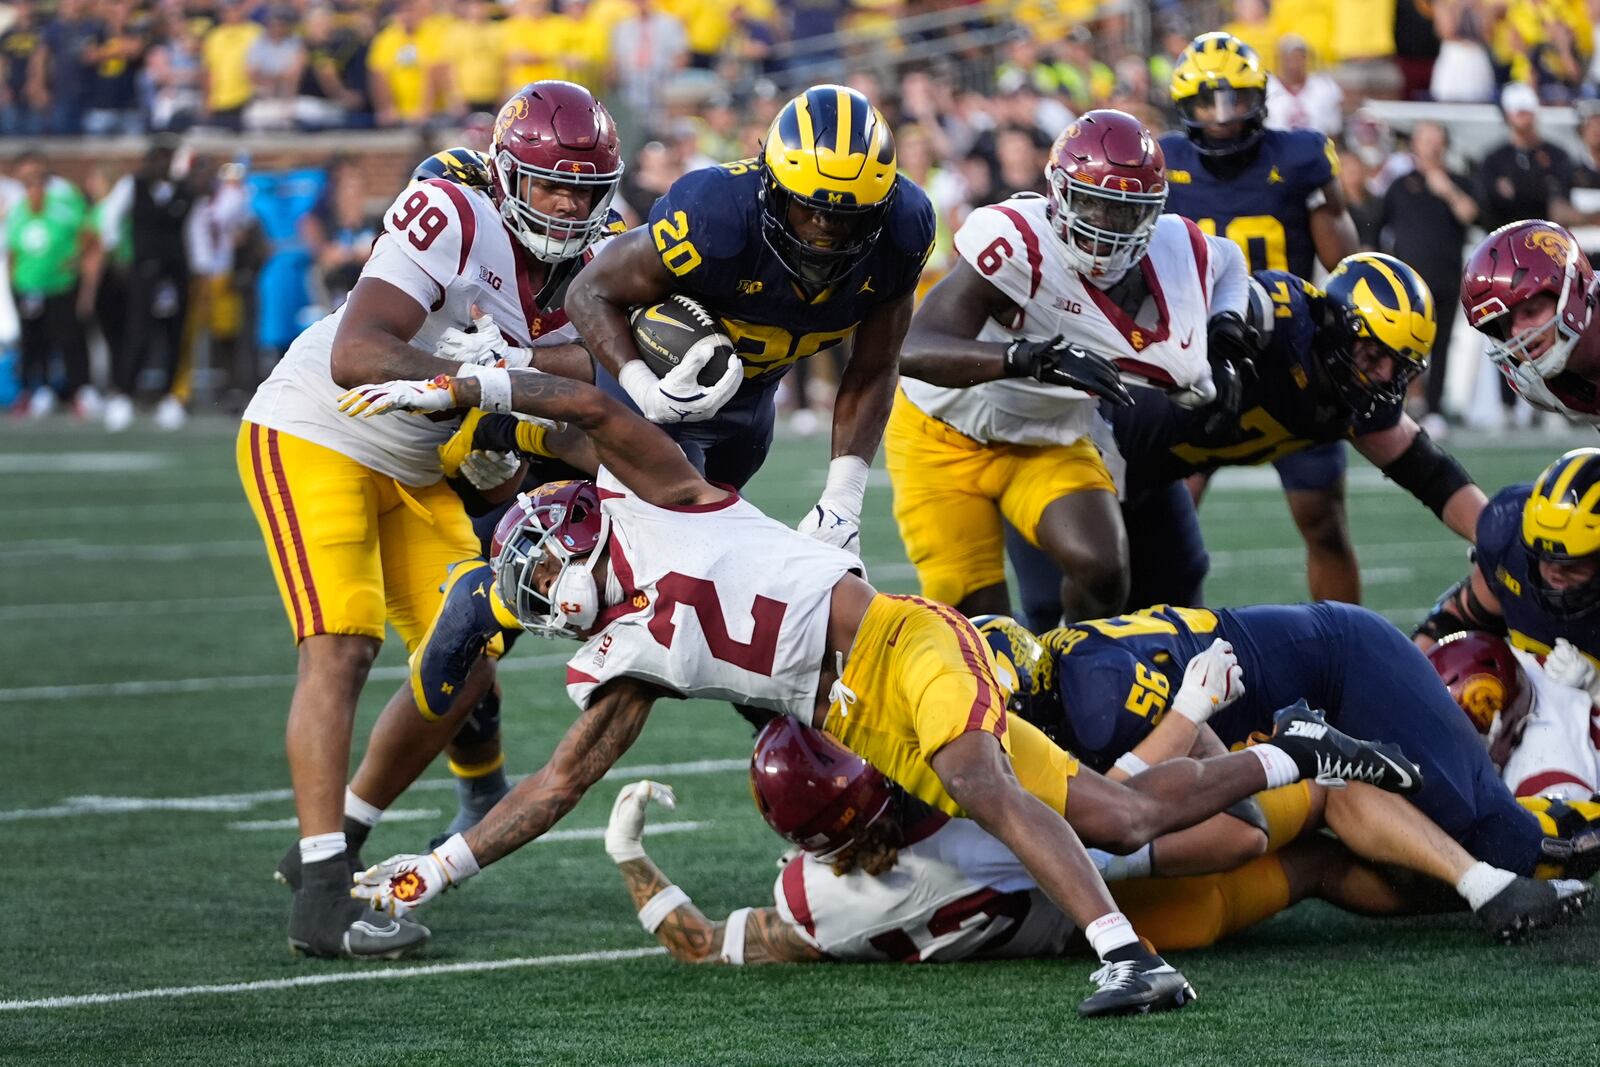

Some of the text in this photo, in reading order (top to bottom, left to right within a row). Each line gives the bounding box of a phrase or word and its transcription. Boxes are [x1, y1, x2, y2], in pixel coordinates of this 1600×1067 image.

[392, 191, 448, 251] 99
[653, 210, 702, 277] 20
[977, 236, 1013, 276] 6
[647, 571, 788, 677] 2
[1125, 661, 1170, 726] 56
[1285, 720, 1328, 741] NIKE
